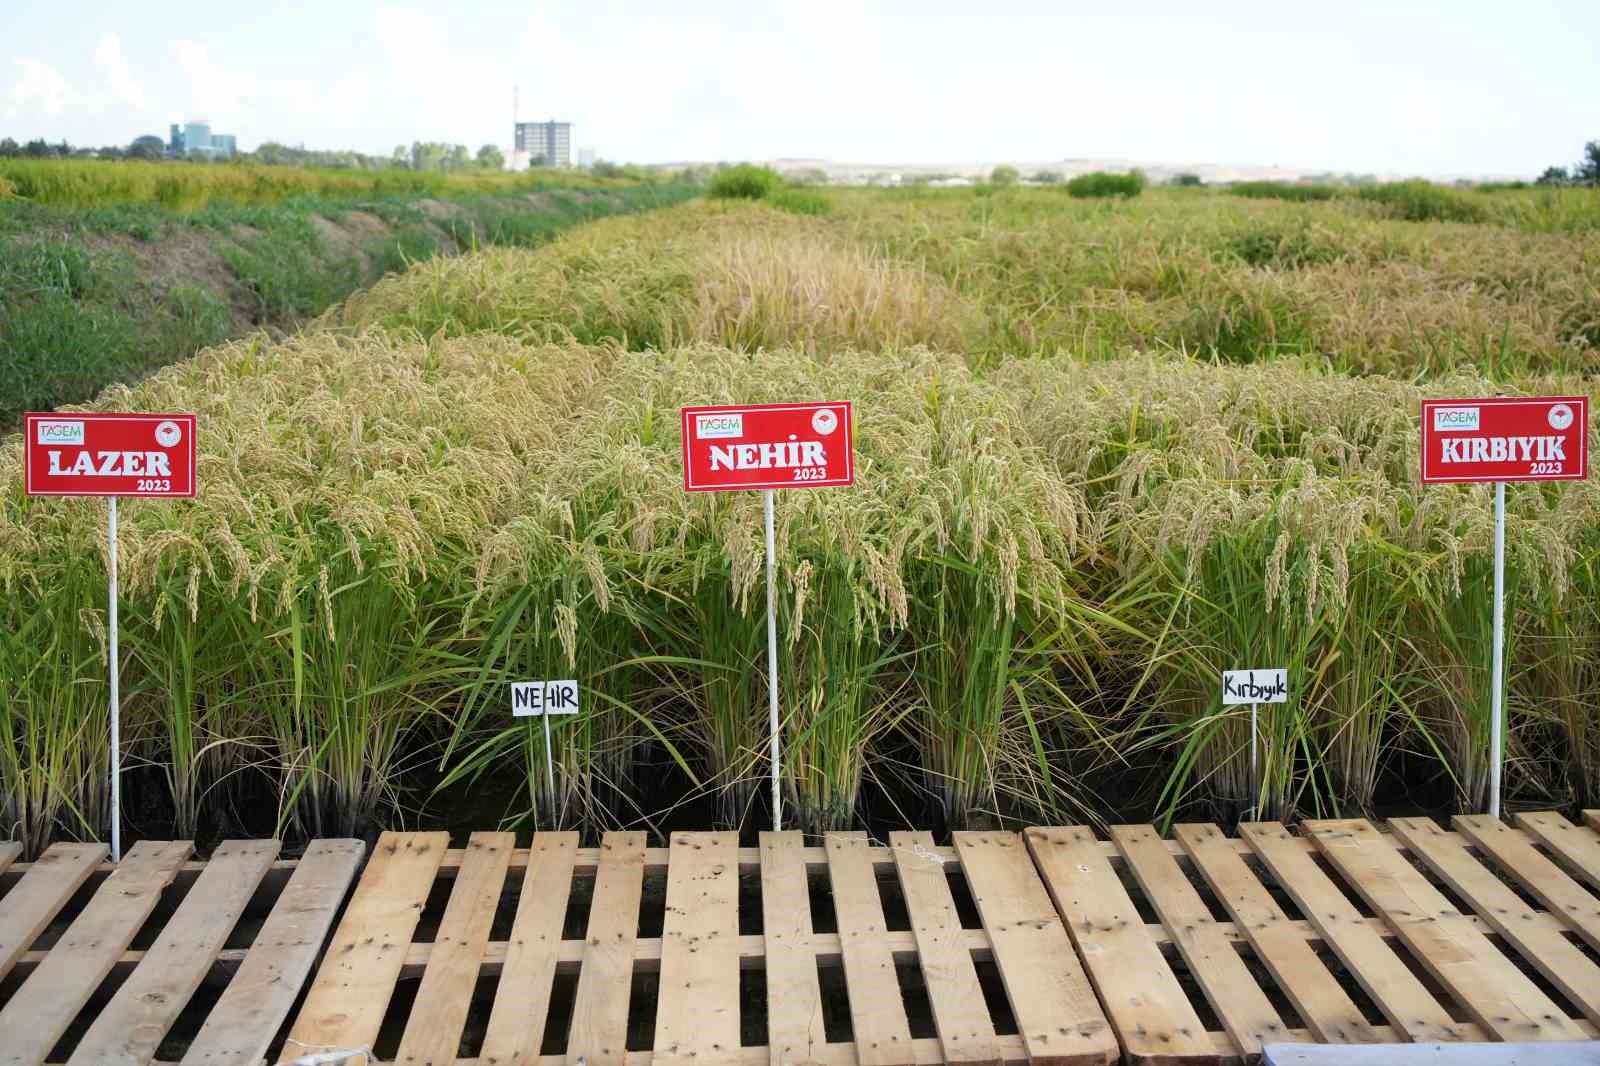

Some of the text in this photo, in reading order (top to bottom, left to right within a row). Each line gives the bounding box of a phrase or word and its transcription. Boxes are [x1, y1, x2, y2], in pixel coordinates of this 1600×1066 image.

[699, 418, 740, 430] TAGEM
[1437, 411, 1477, 424] TAGEM
[40, 424, 81, 437] TAGEM
[709, 434, 827, 470] NEHİR
[1441, 436, 1566, 463] KIRBIYIK
[48, 451, 172, 476] LAZER
[1530, 462, 1563, 474] 2023
[793, 467, 827, 480] 2023
[137, 479, 171, 491] 2023
